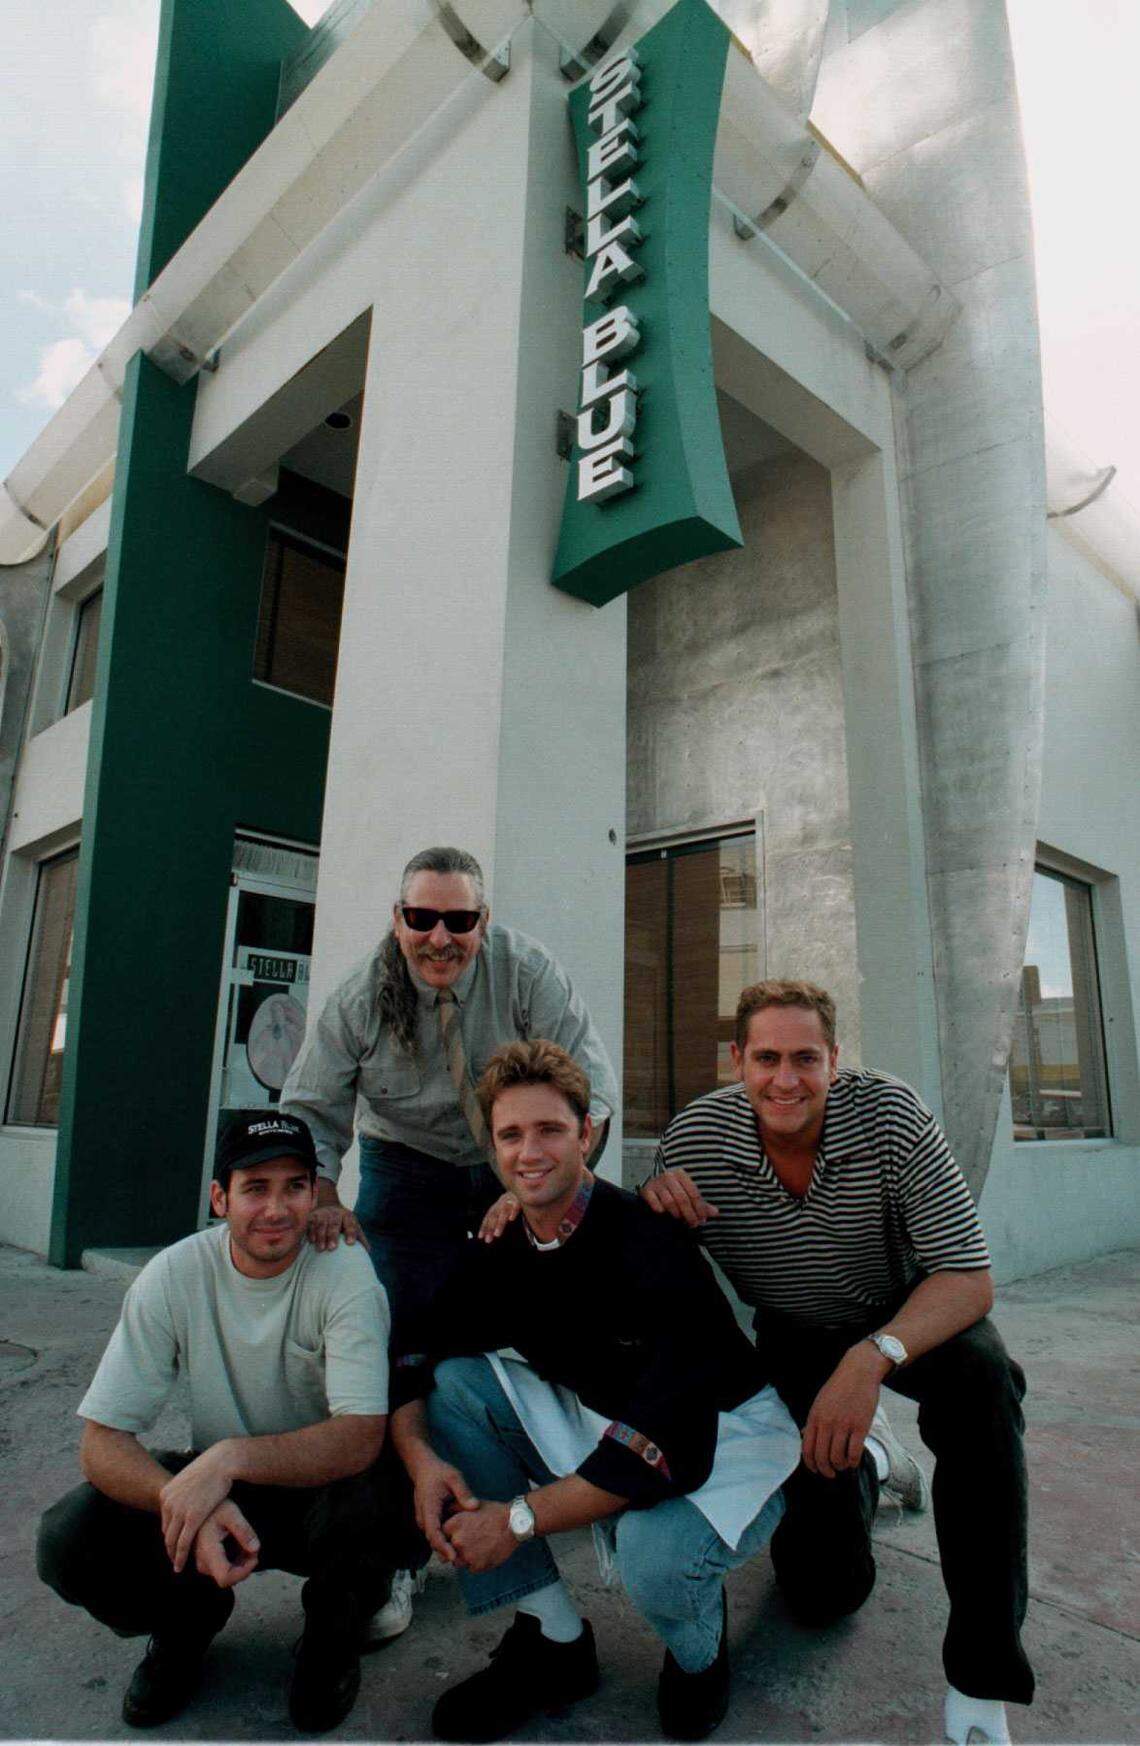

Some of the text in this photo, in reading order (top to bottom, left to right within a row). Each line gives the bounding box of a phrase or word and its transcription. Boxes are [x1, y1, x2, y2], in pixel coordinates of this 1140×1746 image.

[577, 48, 641, 500] STELLA BLUE
[250, 957, 294, 979] STELLA
[248, 1120, 279, 1135] STELLA
